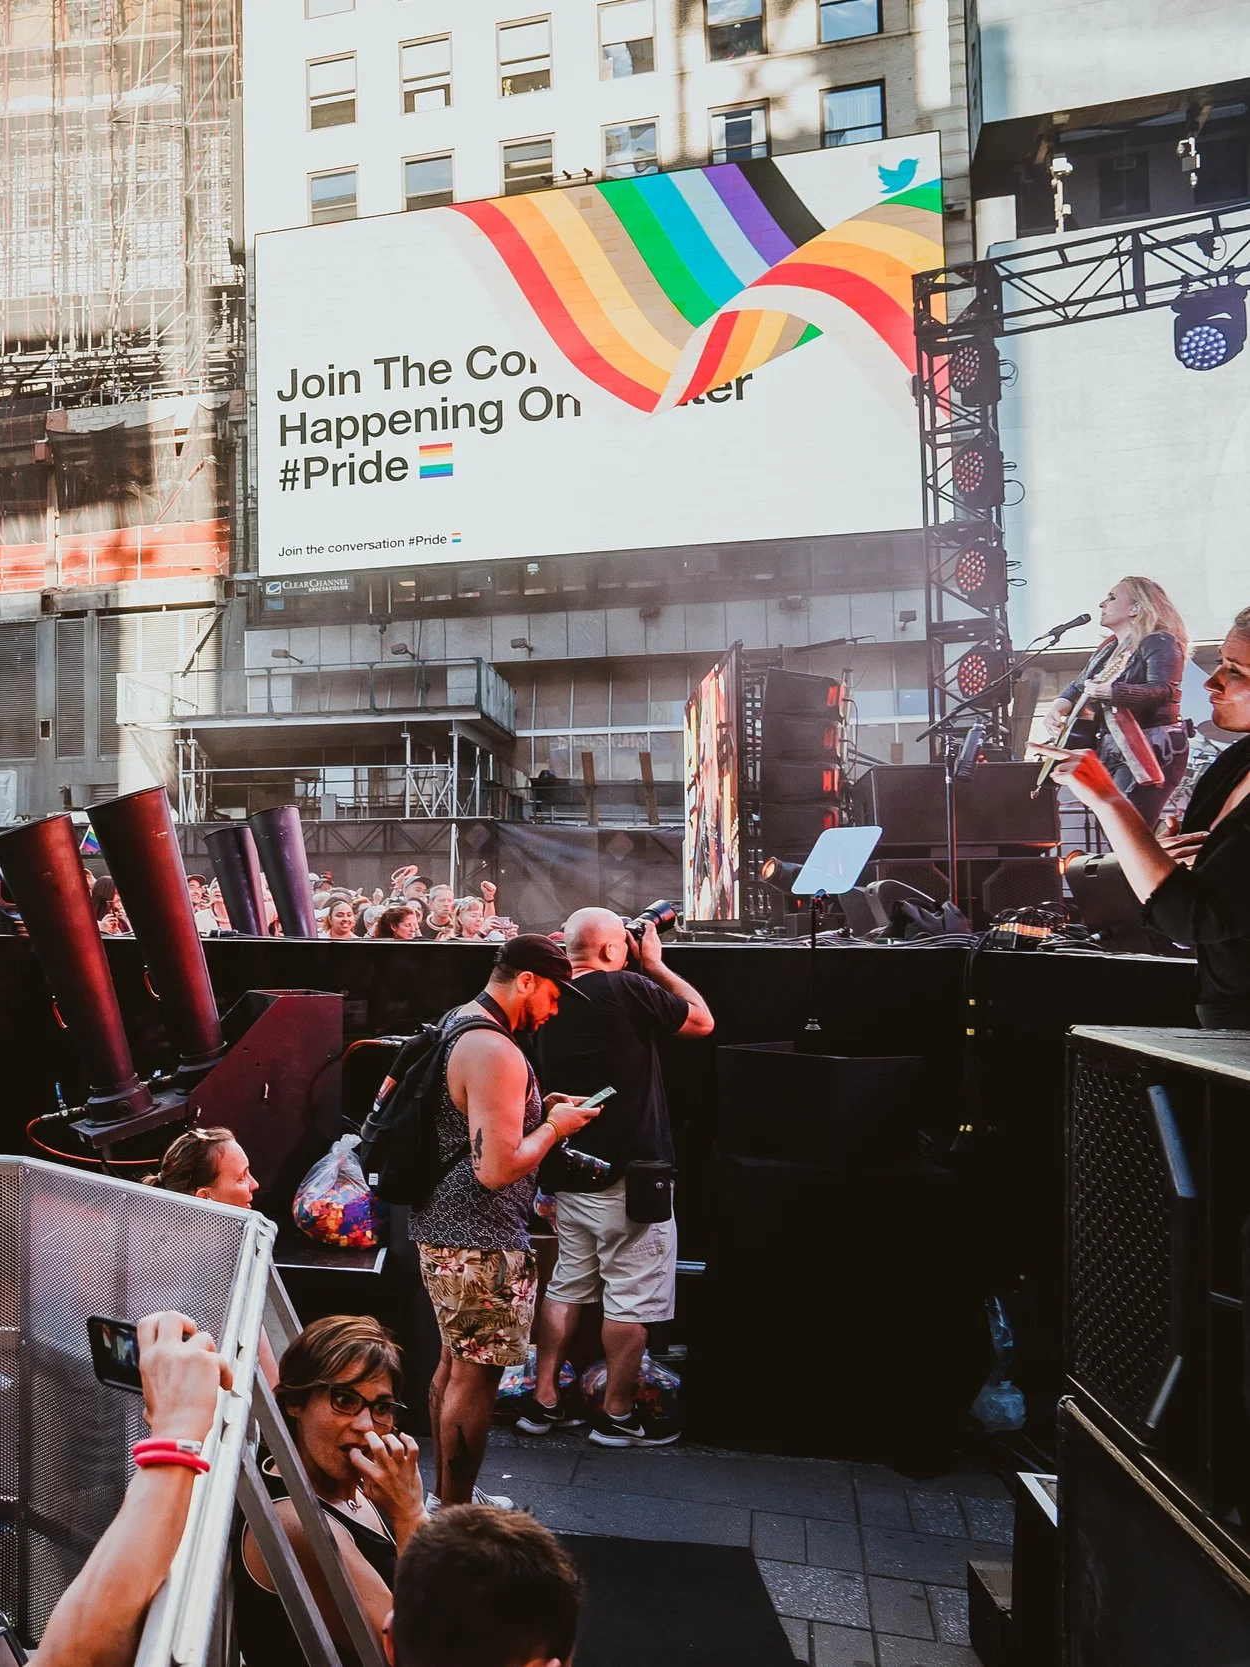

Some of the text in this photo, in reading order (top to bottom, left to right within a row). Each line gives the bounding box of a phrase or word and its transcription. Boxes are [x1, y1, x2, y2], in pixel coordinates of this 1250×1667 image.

[277, 363, 361, 402] Join
[373, 354, 453, 391] The
[279, 396, 503, 450] Happening
[518, 385, 581, 422] On
[278, 449, 410, 492] #Pride
[278, 534, 448, 557] Join the conversation #Pride
